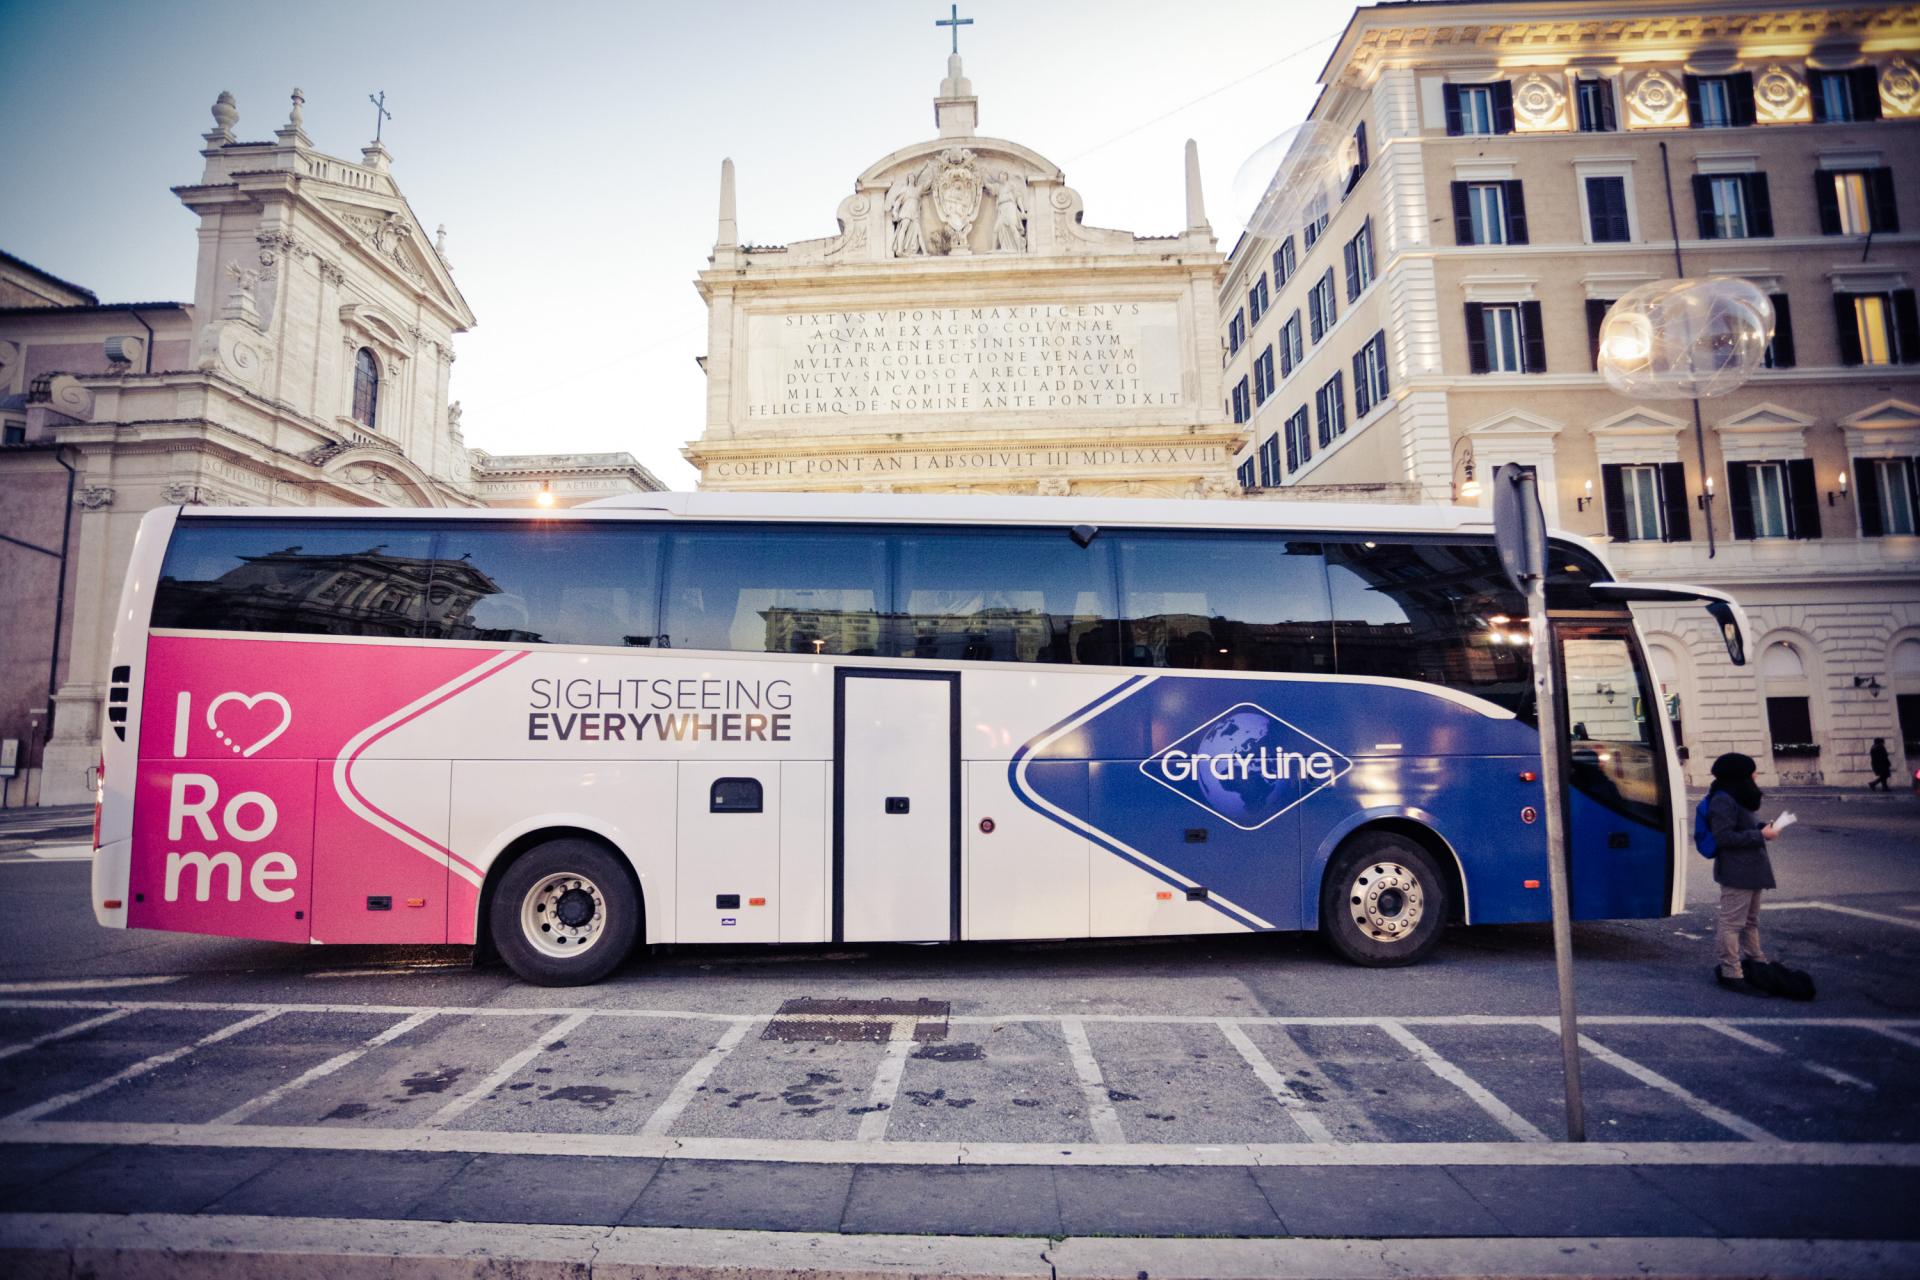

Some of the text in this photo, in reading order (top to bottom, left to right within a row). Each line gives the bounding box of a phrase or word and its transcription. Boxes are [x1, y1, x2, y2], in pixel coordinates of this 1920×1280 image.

[786, 304, 1139, 326] SIXTVS V PONT MAX PICENVS
[814, 320, 1113, 342] AQVAM EX AGRO COLVMNAE
[807, 335, 1121, 354] VIA PRAENEST SINISTRORSVM
[794, 349, 1134, 369] MVLTAR COLLECTIONE VENARVM
[787, 363, 1137, 385] DVCTV SINVOSO A RECEPTACVLO
[788, 388, 823, 400] MIL
[834, 386, 859, 398] XX
[871, 385, 880, 396] A
[892, 382, 969, 395] CAPITE
[1040, 378, 1140, 392] ADDVXIT
[856, 399, 879, 412] DE
[891, 396, 969, 410] NOMINE
[984, 396, 1036, 408] ANTE
[1049, 394, 1102, 406] PONT
[1116, 393, 1179, 404] DIXIT
[719, 448, 1216, 476] COEPIT PONT AN I ABSOLVIT III MDLXXXVII
[530, 679, 792, 710] SIGHTSEEING
[173, 691, 191, 757] I
[529, 713, 791, 742] EVERYWHERE
